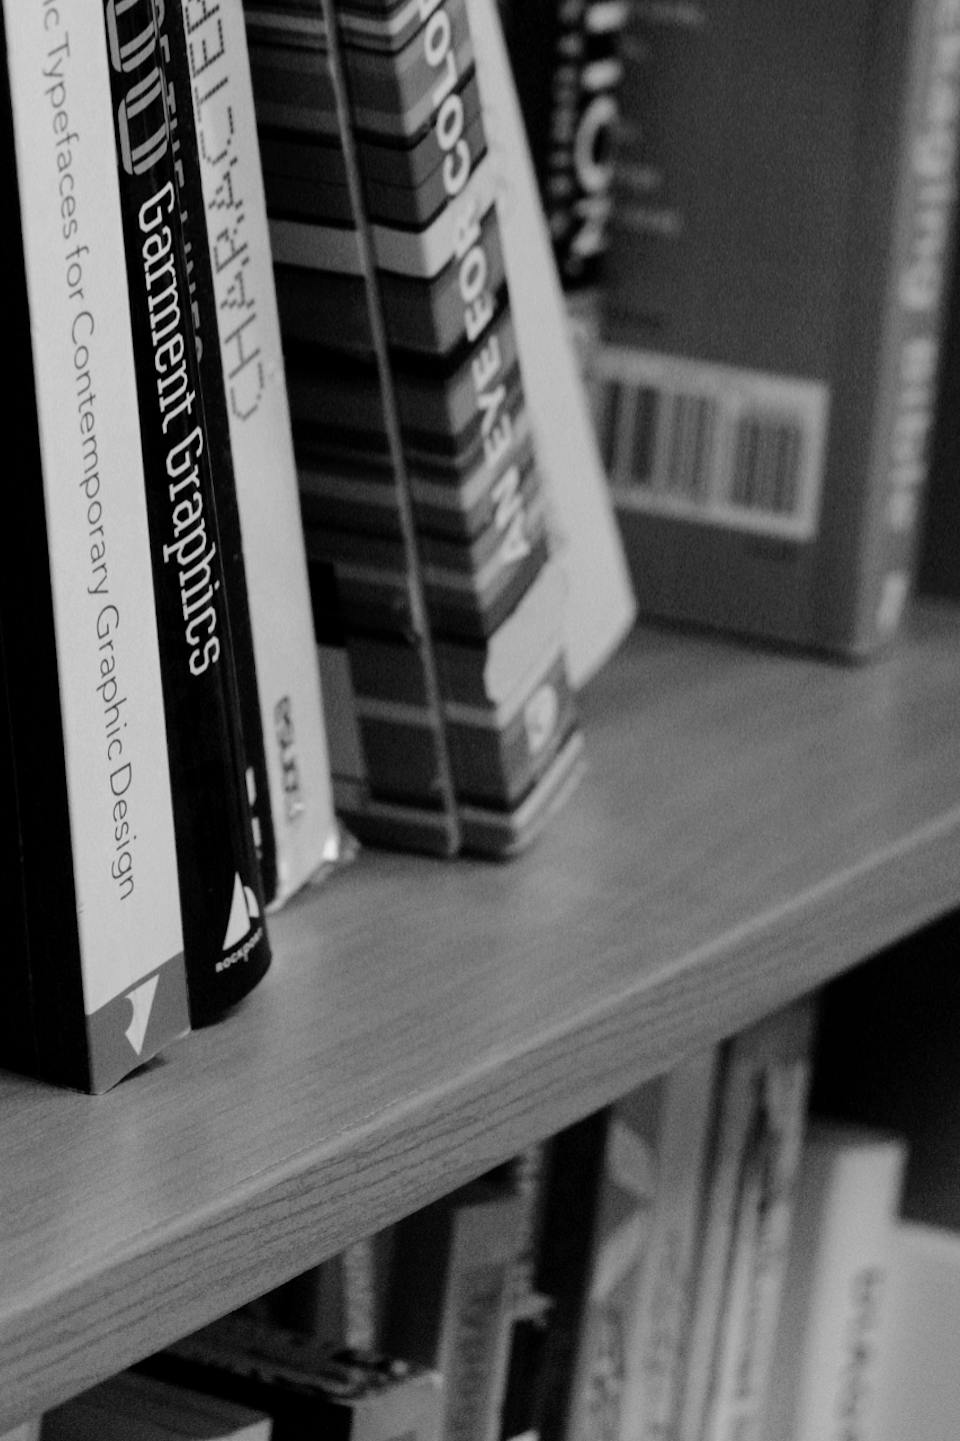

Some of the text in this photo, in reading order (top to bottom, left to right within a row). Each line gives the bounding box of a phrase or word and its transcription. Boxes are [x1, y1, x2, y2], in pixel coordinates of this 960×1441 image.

[43, 32, 80, 239] Typefaces
[64, 243, 90, 306] for
[139, 180, 196, 435] Garment
[71, 310, 110, 596] Contemporary
[163, 423, 222, 677] Graphics
[96, 604, 133, 761] Graphic
[110, 763, 138, 901] Design
